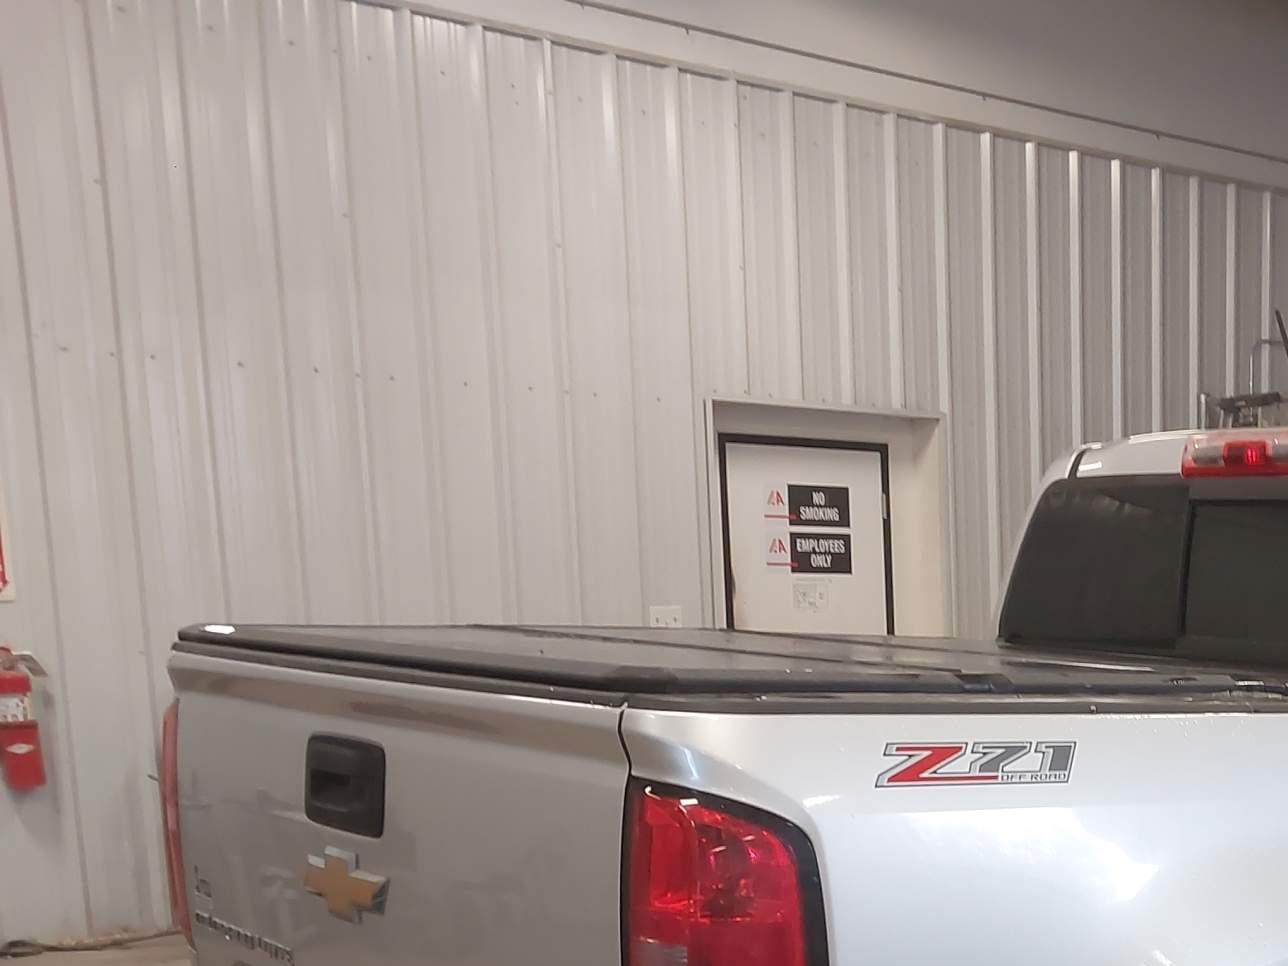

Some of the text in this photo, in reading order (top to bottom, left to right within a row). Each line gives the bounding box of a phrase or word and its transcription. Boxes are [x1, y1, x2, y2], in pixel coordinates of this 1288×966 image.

[812, 491, 826, 506] NO
[799, 505, 840, 522] SMOKING
[795, 538, 846, 554] EMPLOYEES
[810, 553, 833, 568] ONLY
[875, 741, 1077, 788] Z71
[1000, 772, 1067, 782] OFF ROAD
